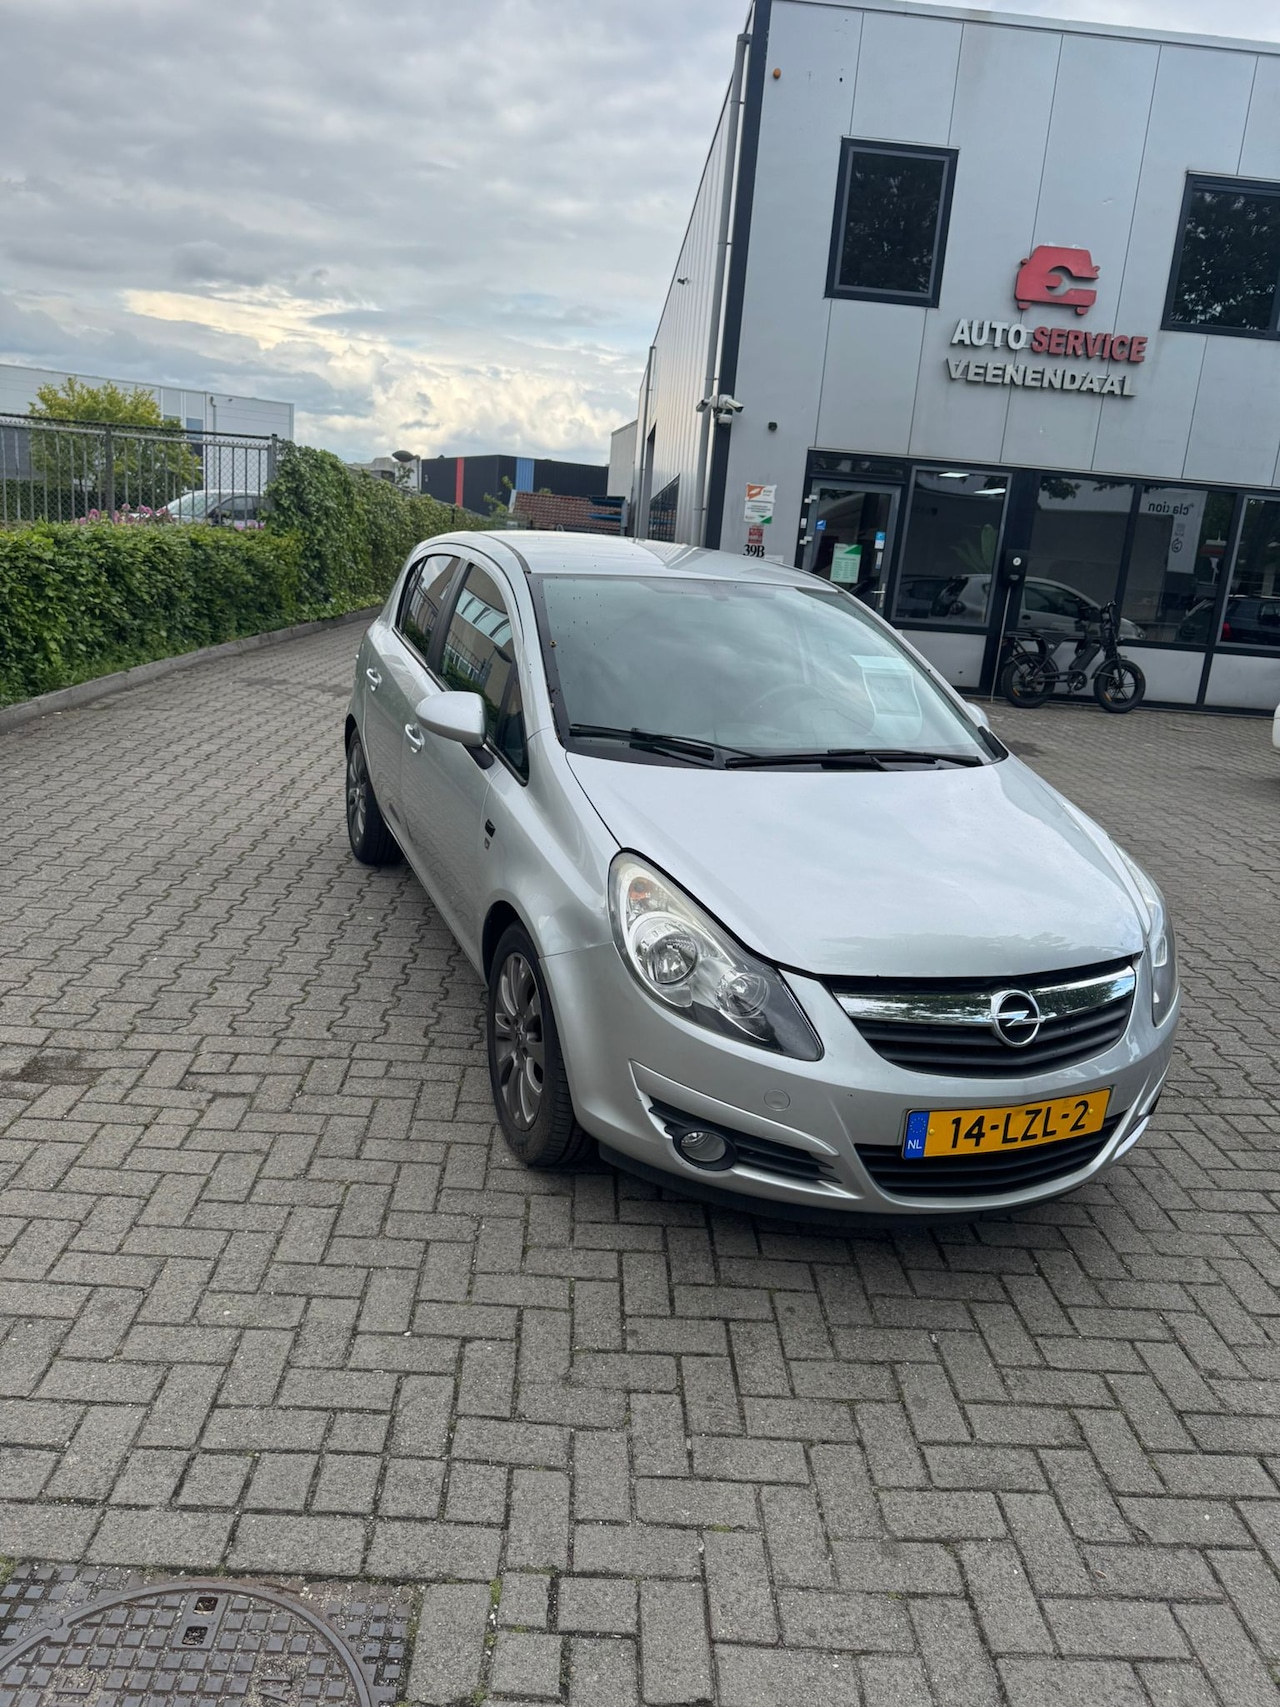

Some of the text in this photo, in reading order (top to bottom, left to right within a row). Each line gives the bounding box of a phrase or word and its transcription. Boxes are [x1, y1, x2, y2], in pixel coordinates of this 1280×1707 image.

[950, 318, 1149, 363] AUTO SERVICE
[946, 358, 1137, 397] VEENENDAAL
[742, 544, 765, 558] 39B
[951, 1100, 1090, 1149] 14-LZL-2
[907, 1139, 923, 1150] NL
